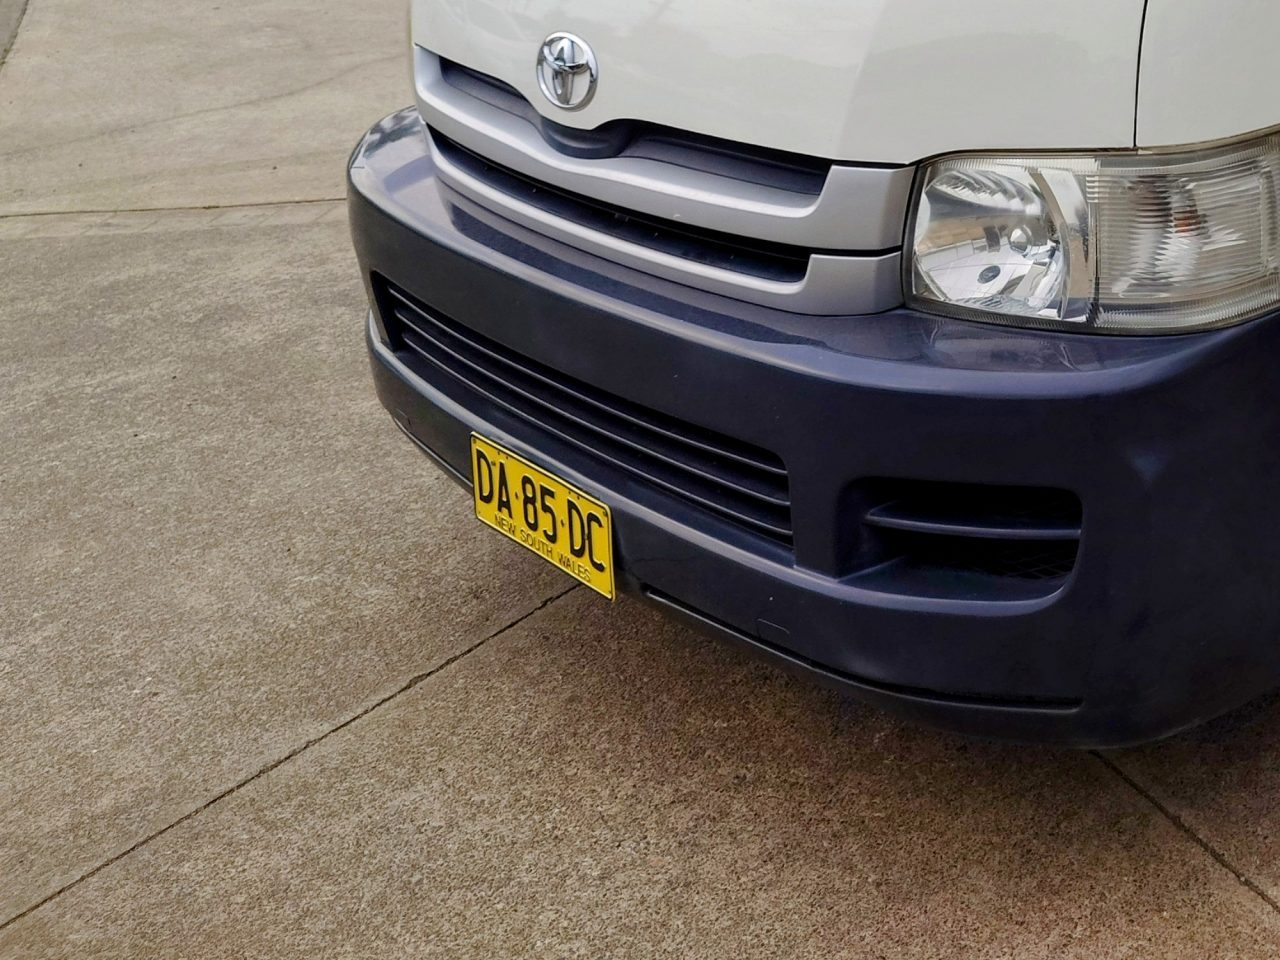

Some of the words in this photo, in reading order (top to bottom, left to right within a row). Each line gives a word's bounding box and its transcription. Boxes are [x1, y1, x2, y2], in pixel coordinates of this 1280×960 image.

[476, 448, 513, 520] DA
[521, 474, 558, 545] 85
[567, 498, 606, 573] DC
[494, 513, 517, 537] NEW
[520, 529, 553, 559] SOUTH
[558, 550, 592, 583] WALES
